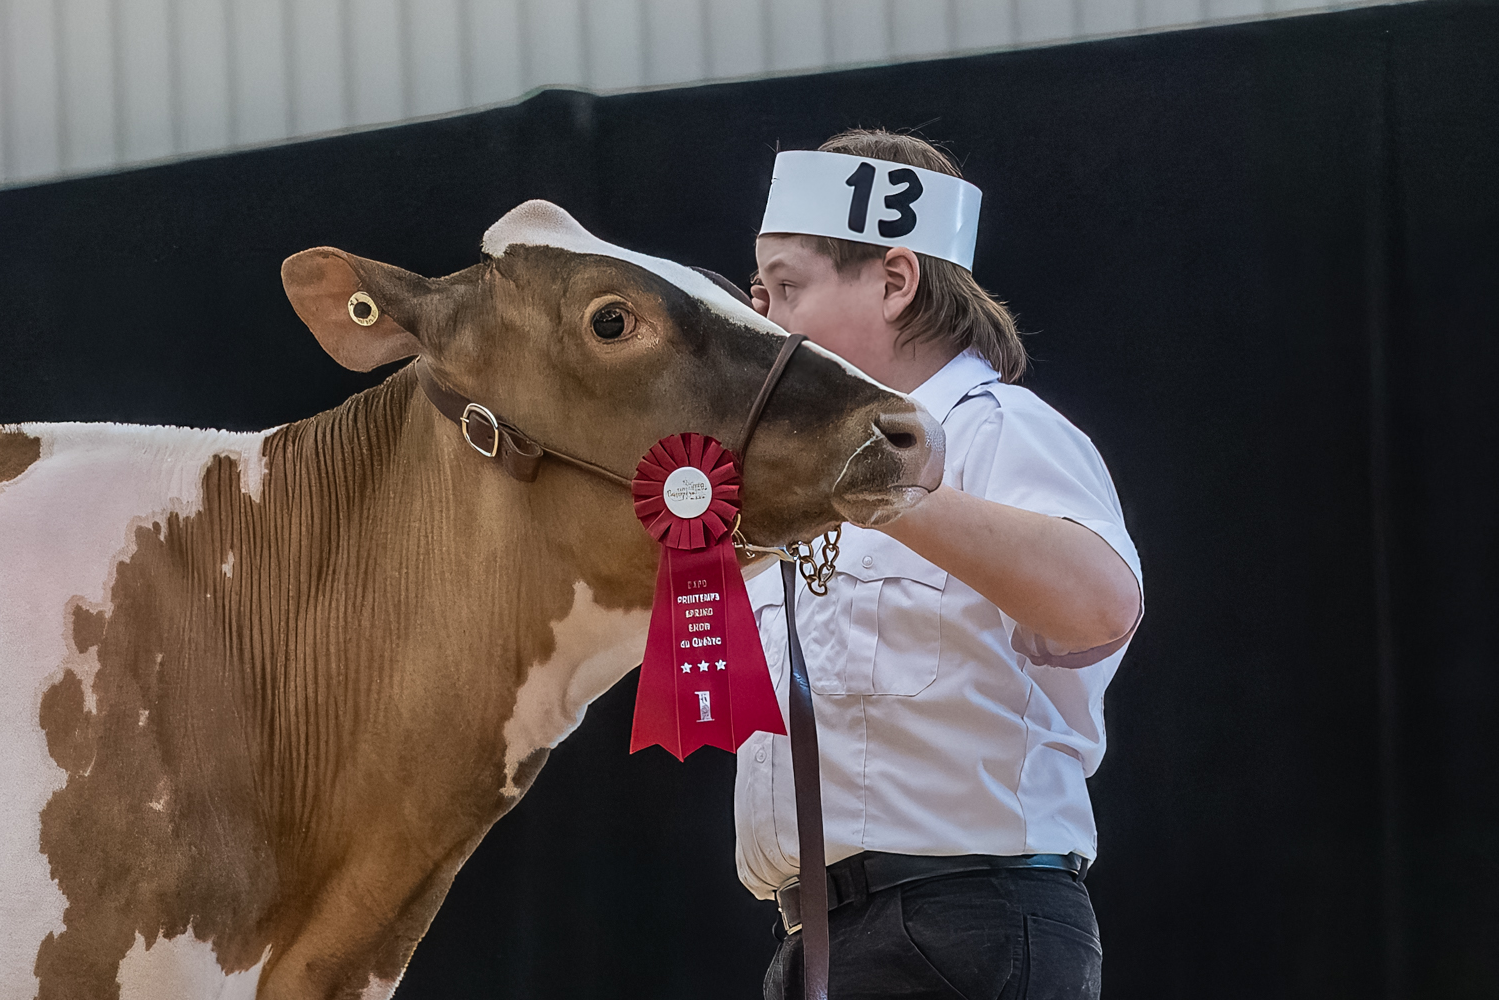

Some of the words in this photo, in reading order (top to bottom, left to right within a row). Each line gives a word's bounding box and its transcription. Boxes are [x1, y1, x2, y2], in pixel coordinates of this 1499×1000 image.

[845, 161, 924, 239] 13
[677, 592, 720, 604] PRINTEMPS
[685, 607, 713, 618] SPRING
